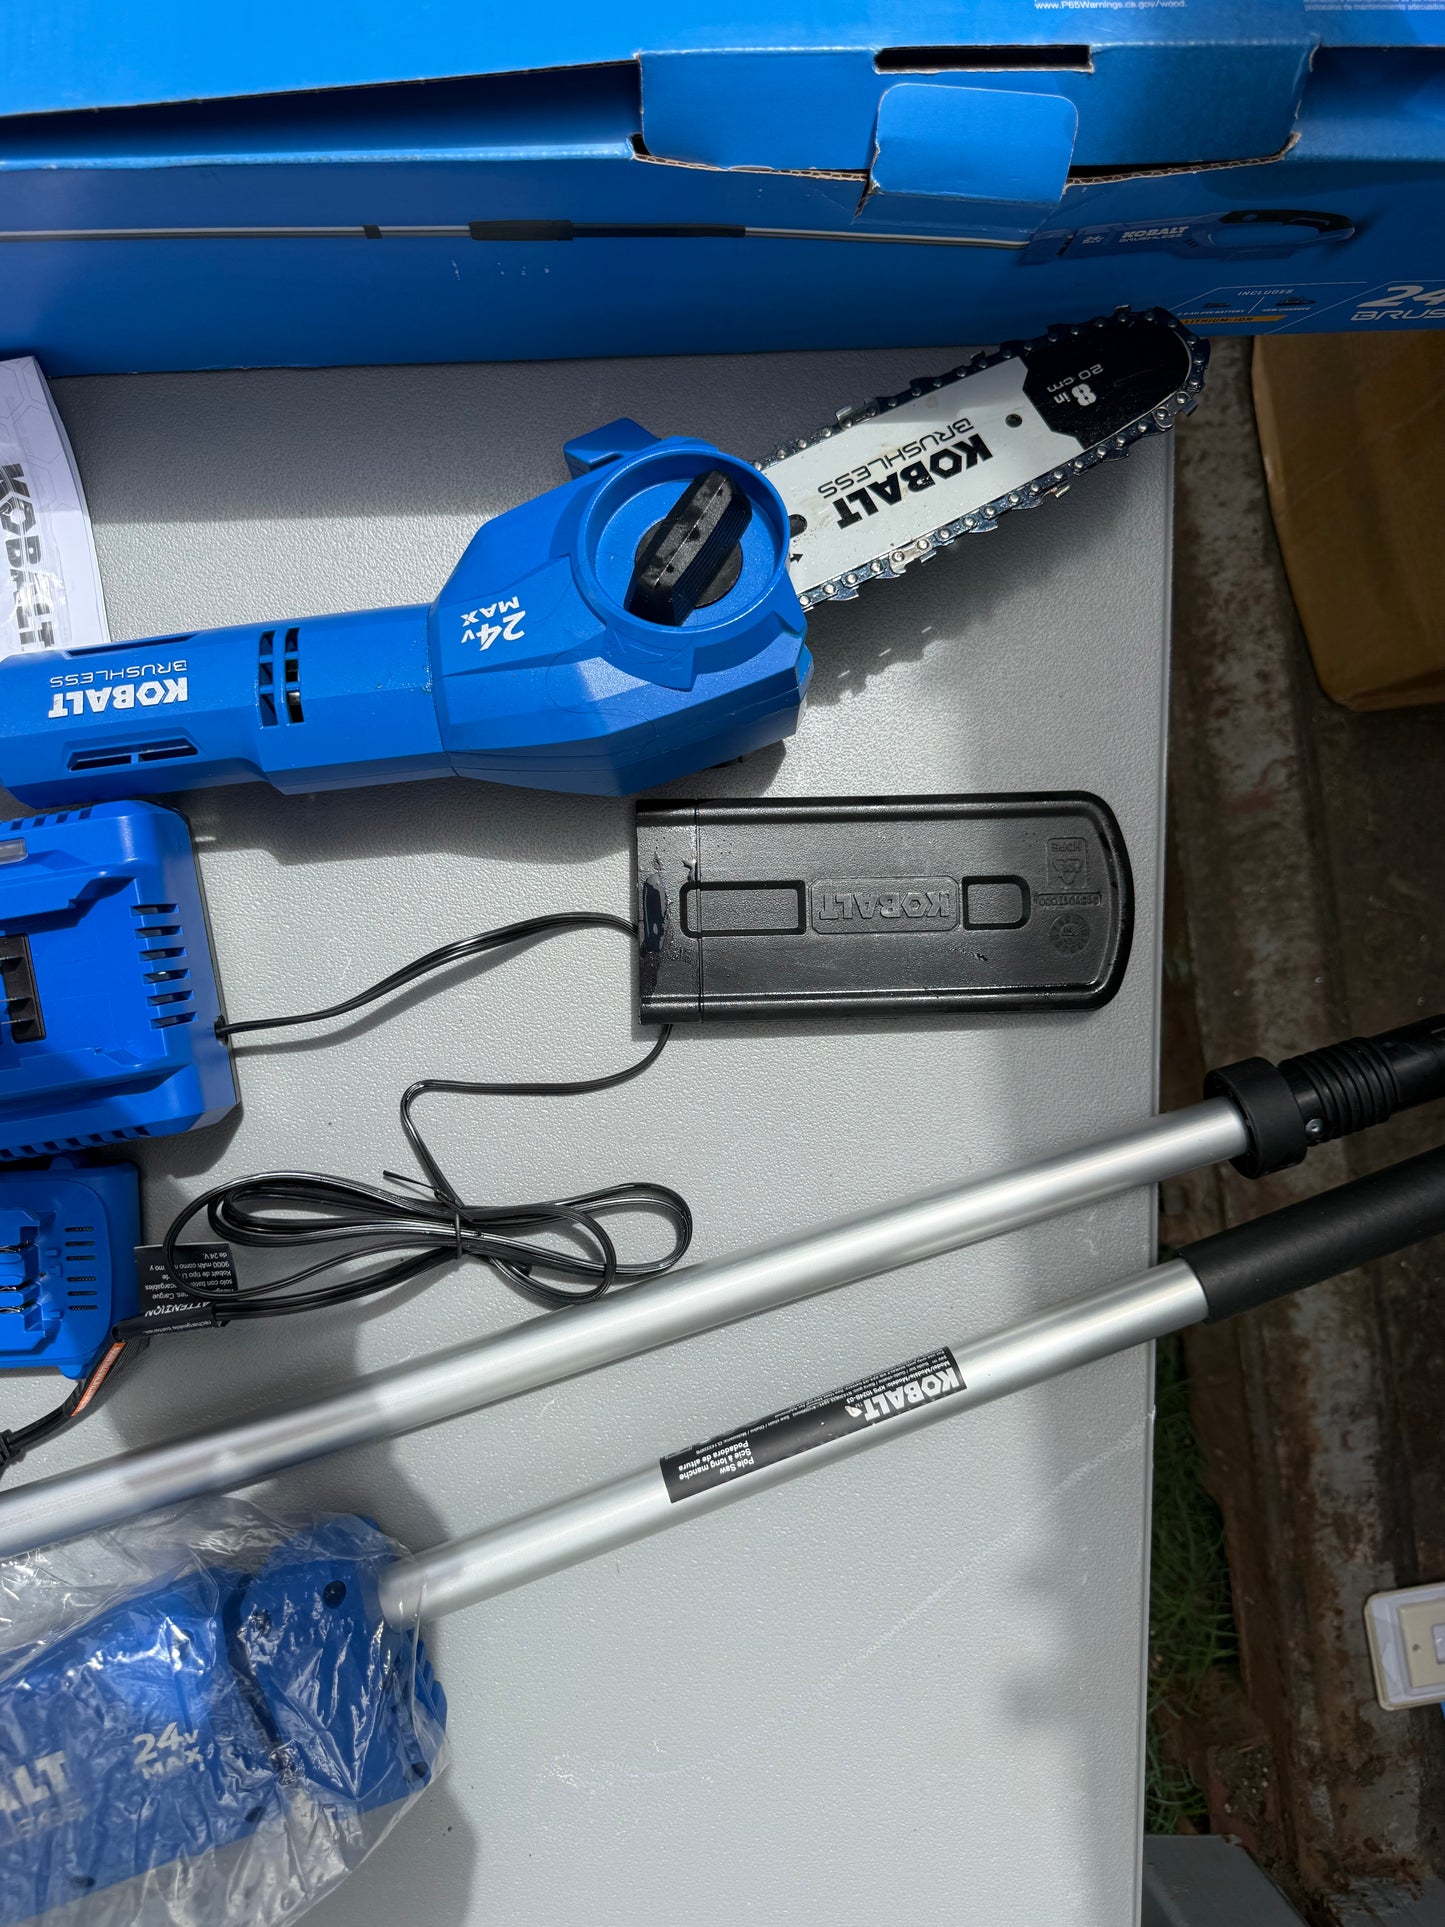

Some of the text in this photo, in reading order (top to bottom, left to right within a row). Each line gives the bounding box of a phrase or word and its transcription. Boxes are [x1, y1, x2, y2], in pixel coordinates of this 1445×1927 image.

[1122, 226, 1189, 238] KOBALT
[1237, 289, 1294, 297] INCLUDES
[1046, 362, 1103, 394] 20 cm
[1053, 383, 1095, 407] 8 in
[817, 417, 973, 499] BRUSHLESS
[831, 432, 992, 529] KOBALT
[460, 596, 519, 626] MAX
[50, 660, 188, 689] BRUSHLESS
[49, 677, 189, 719] KOBALT
[819, 892, 949, 919] KOBALT
[211, 1269, 231, 1277] Kobalt
[866, 1366, 961, 1421] KOBALT
[872, 1384, 885, 1393] KPS
[677, 1440, 749, 1472] Podadora de altura
[678, 1447, 751, 1481] Scie à long manche
[718, 1456, 754, 1475] Pole Saw
[141, 1746, 203, 1779] MAX
